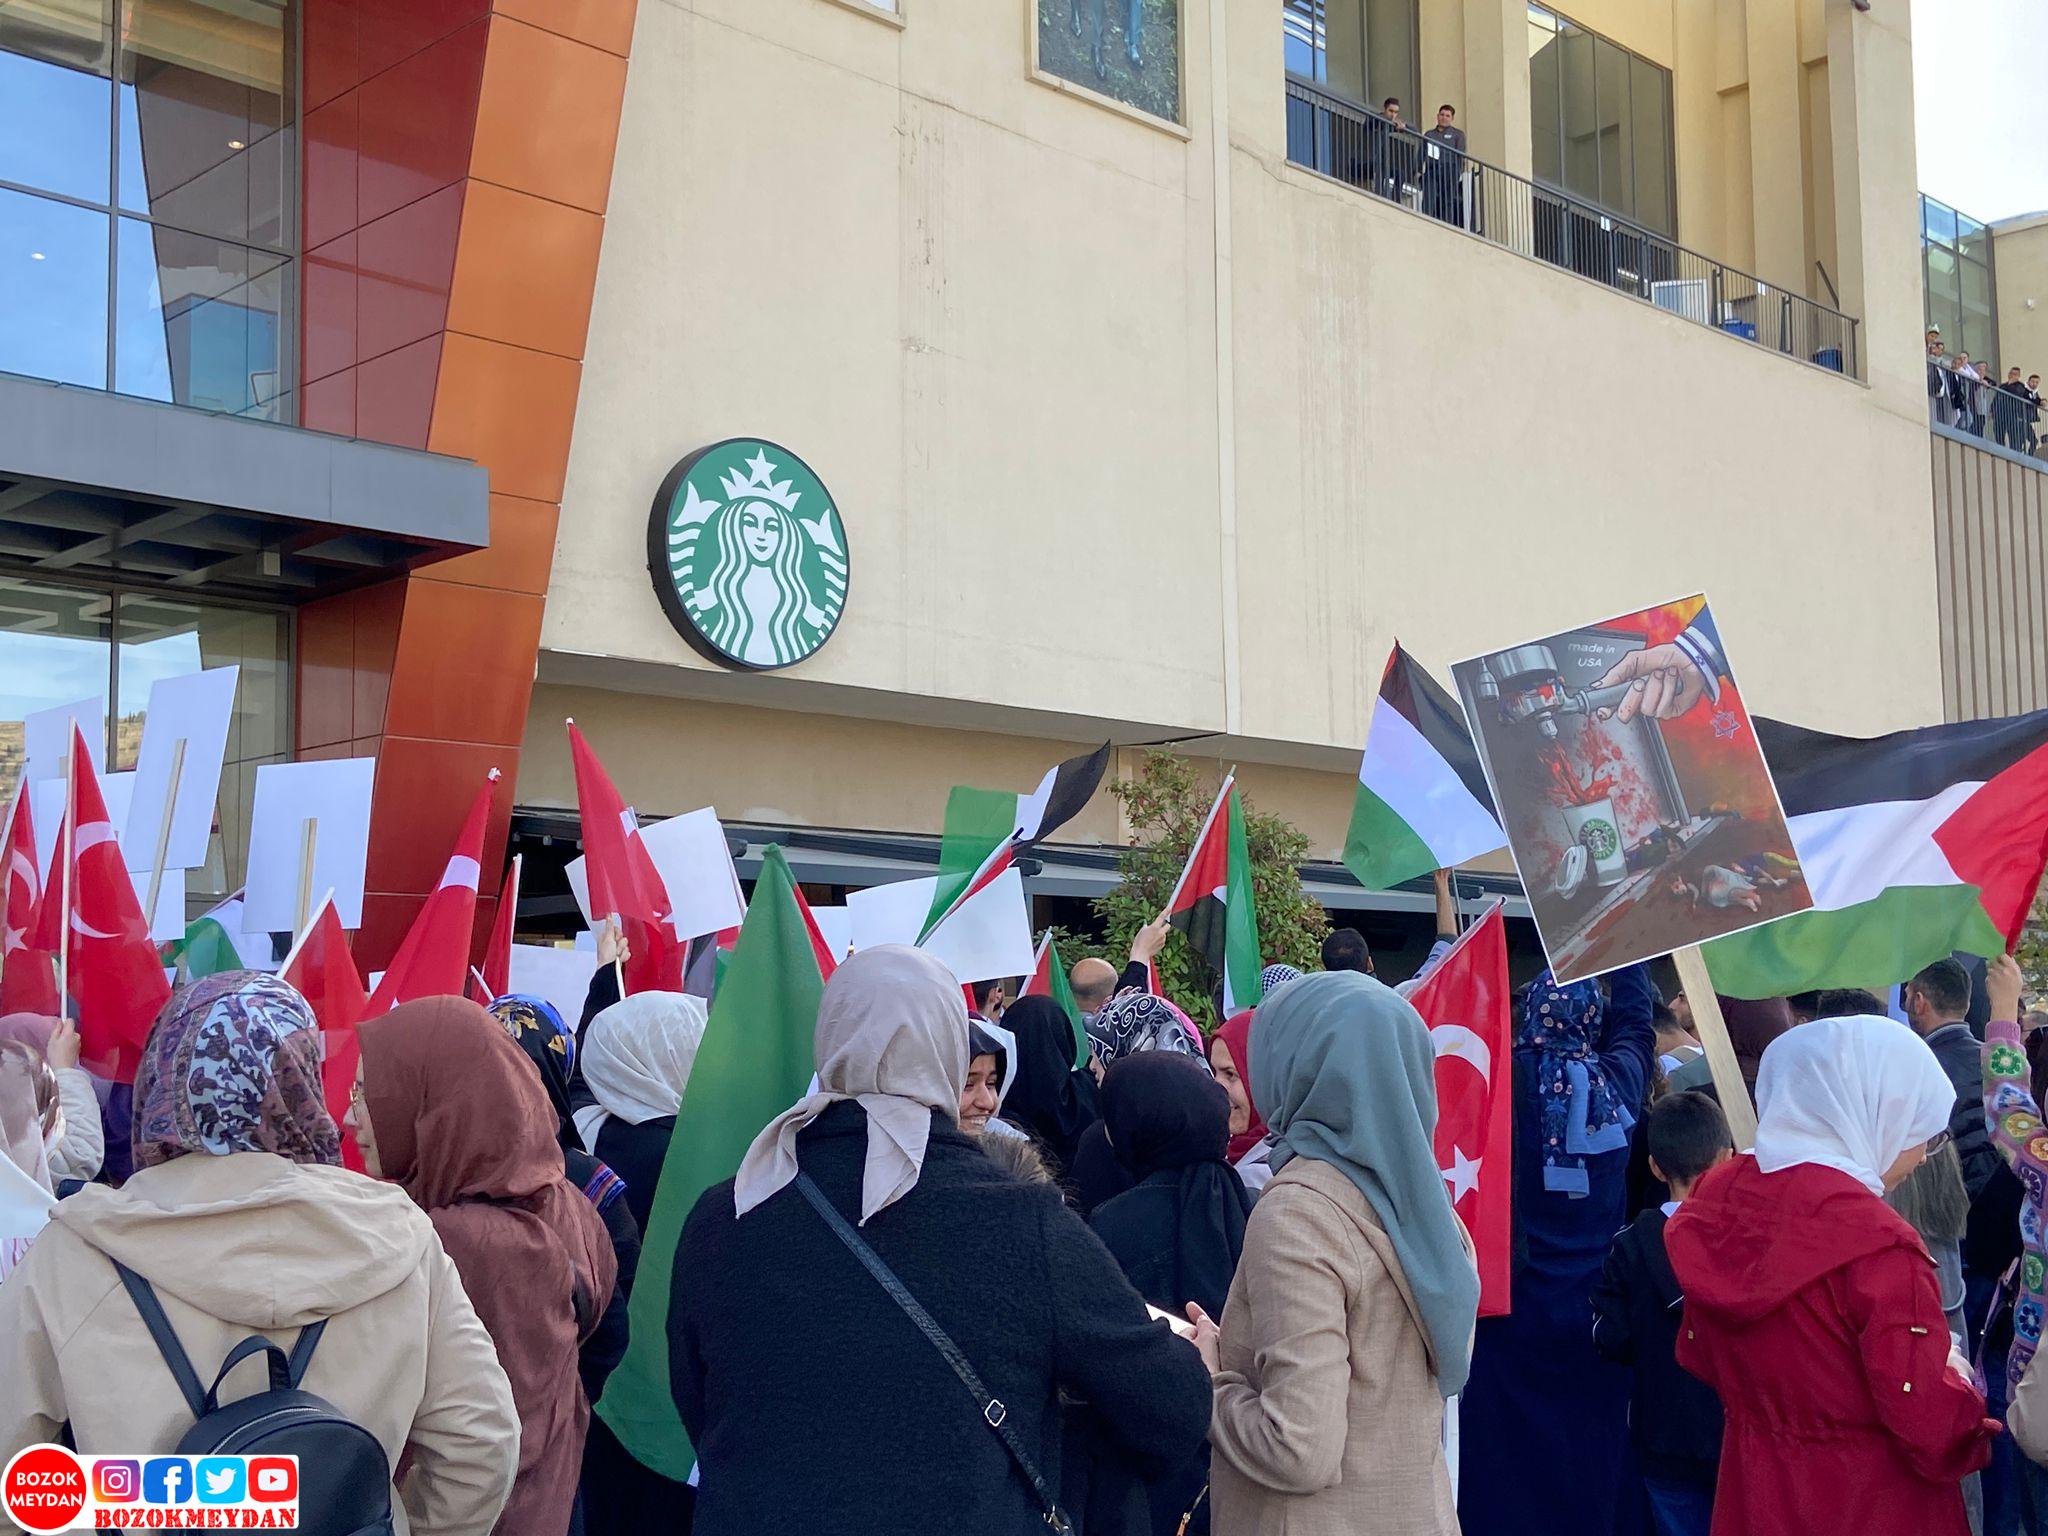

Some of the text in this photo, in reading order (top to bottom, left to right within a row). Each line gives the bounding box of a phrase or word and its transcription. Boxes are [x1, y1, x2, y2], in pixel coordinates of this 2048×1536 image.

[1568, 643, 1615, 654] made in
[1578, 657, 1602, 667] USA
